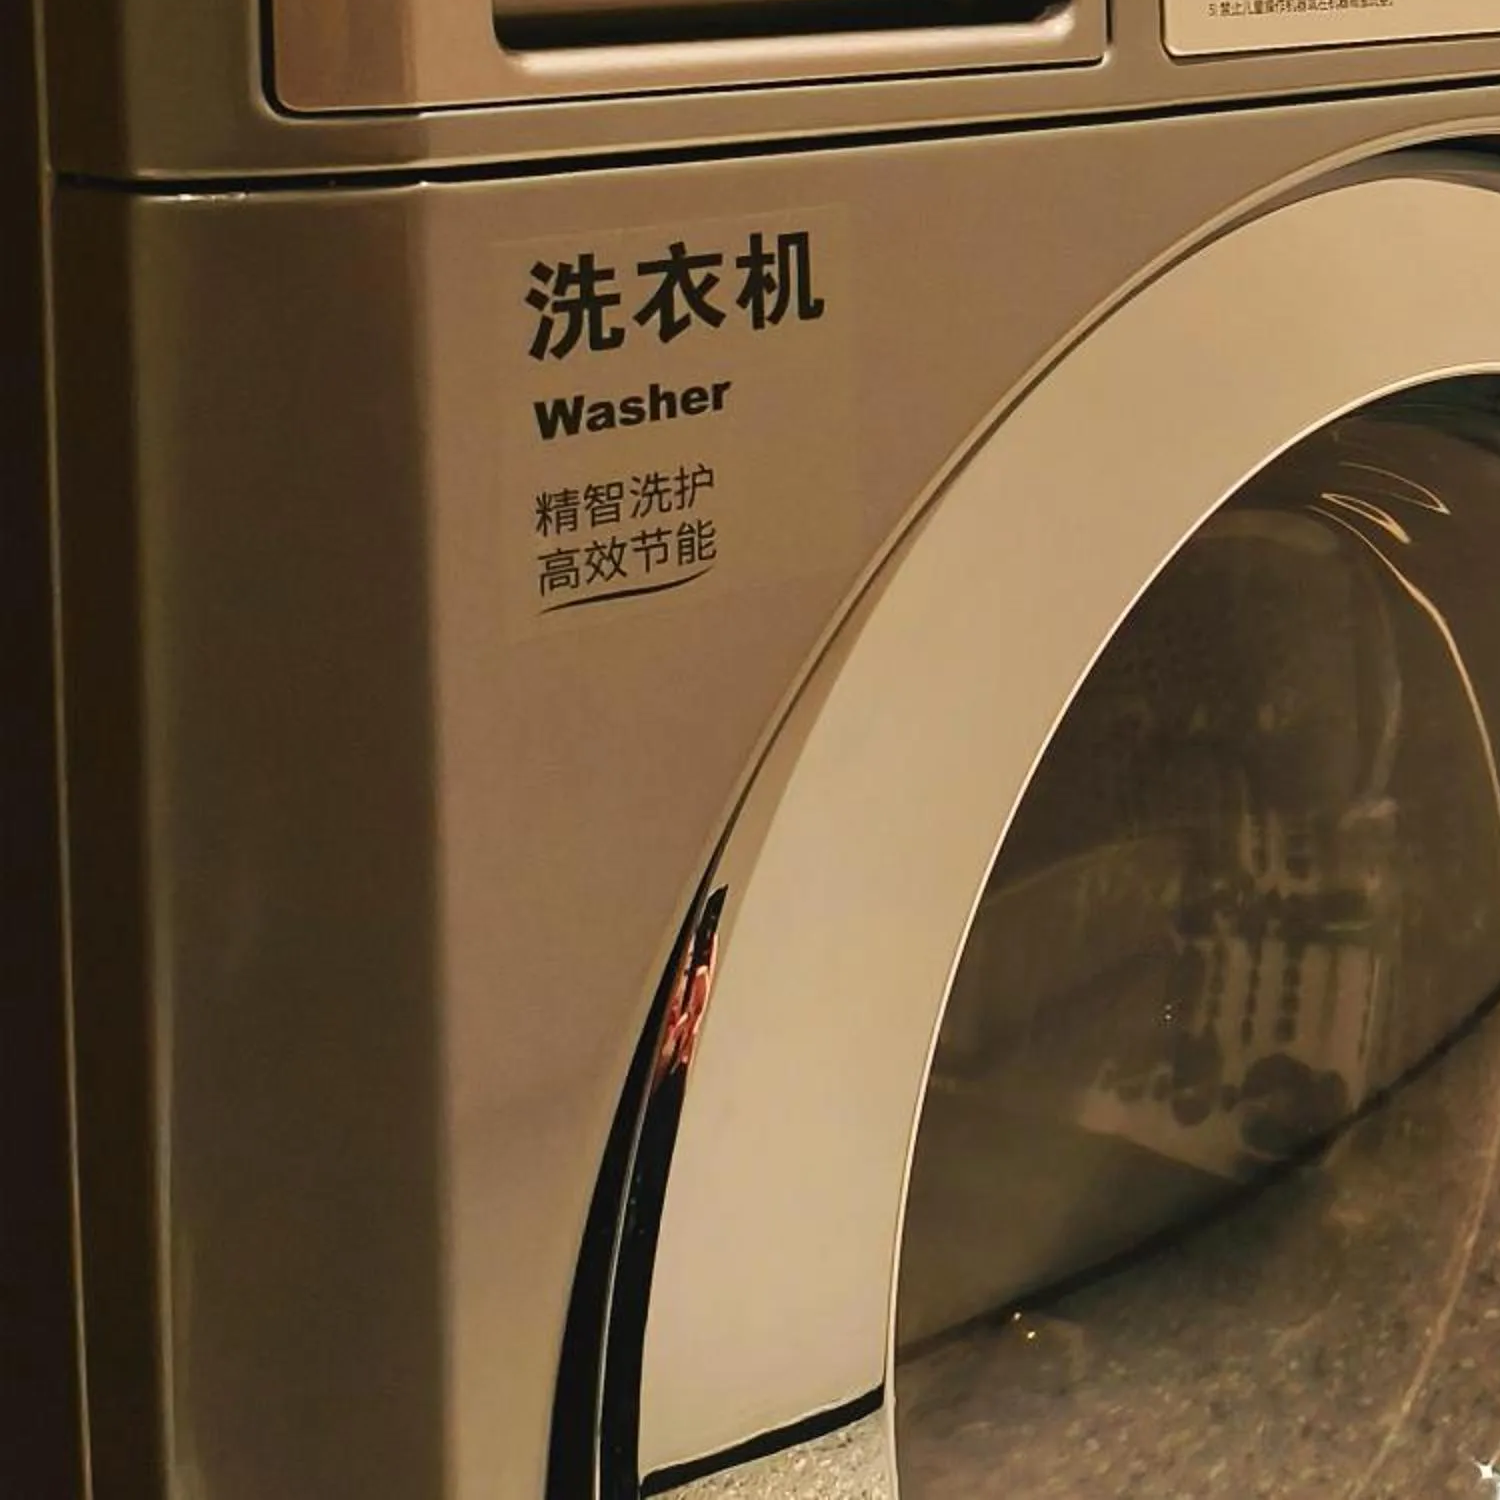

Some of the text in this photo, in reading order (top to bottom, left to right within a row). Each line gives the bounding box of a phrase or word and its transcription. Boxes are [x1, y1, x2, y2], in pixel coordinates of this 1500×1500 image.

[525, 231, 825, 361] 洗衣机
[533, 381, 732, 440] Washer
[535, 463, 715, 538] 精智洗护
[537, 519, 718, 597] 高效节能
